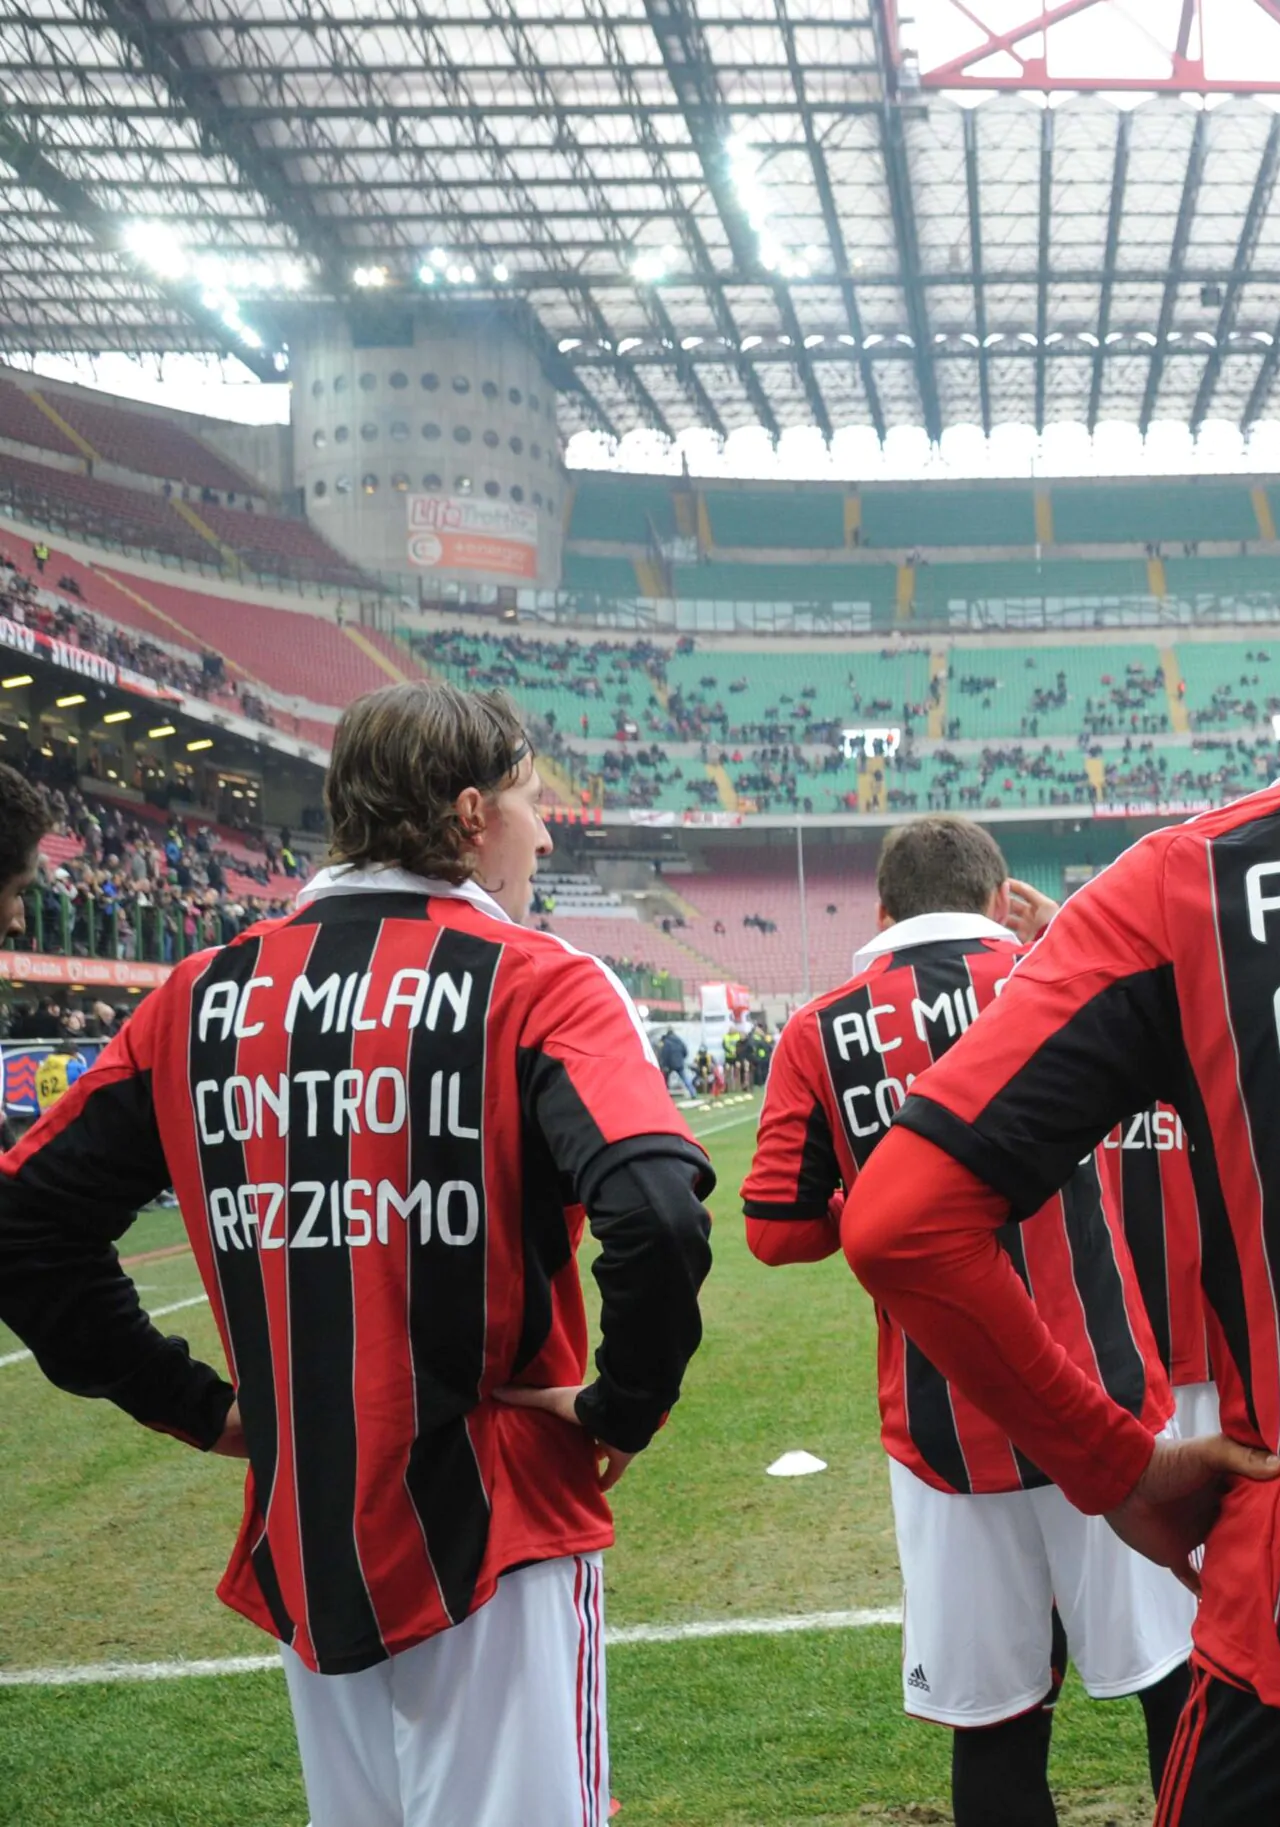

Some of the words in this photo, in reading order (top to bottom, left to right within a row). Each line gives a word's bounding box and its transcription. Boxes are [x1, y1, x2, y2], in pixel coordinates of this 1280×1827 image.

[199, 976, 273, 1042] AC
[284, 968, 473, 1033] MILAN
[833, 1004, 902, 1061] AC
[41, 1076, 62, 1098] 62
[196, 1066, 407, 1145] CONTRO
[429, 1069, 480, 1140] IL
[209, 1178, 480, 1252] RAZZISMO
